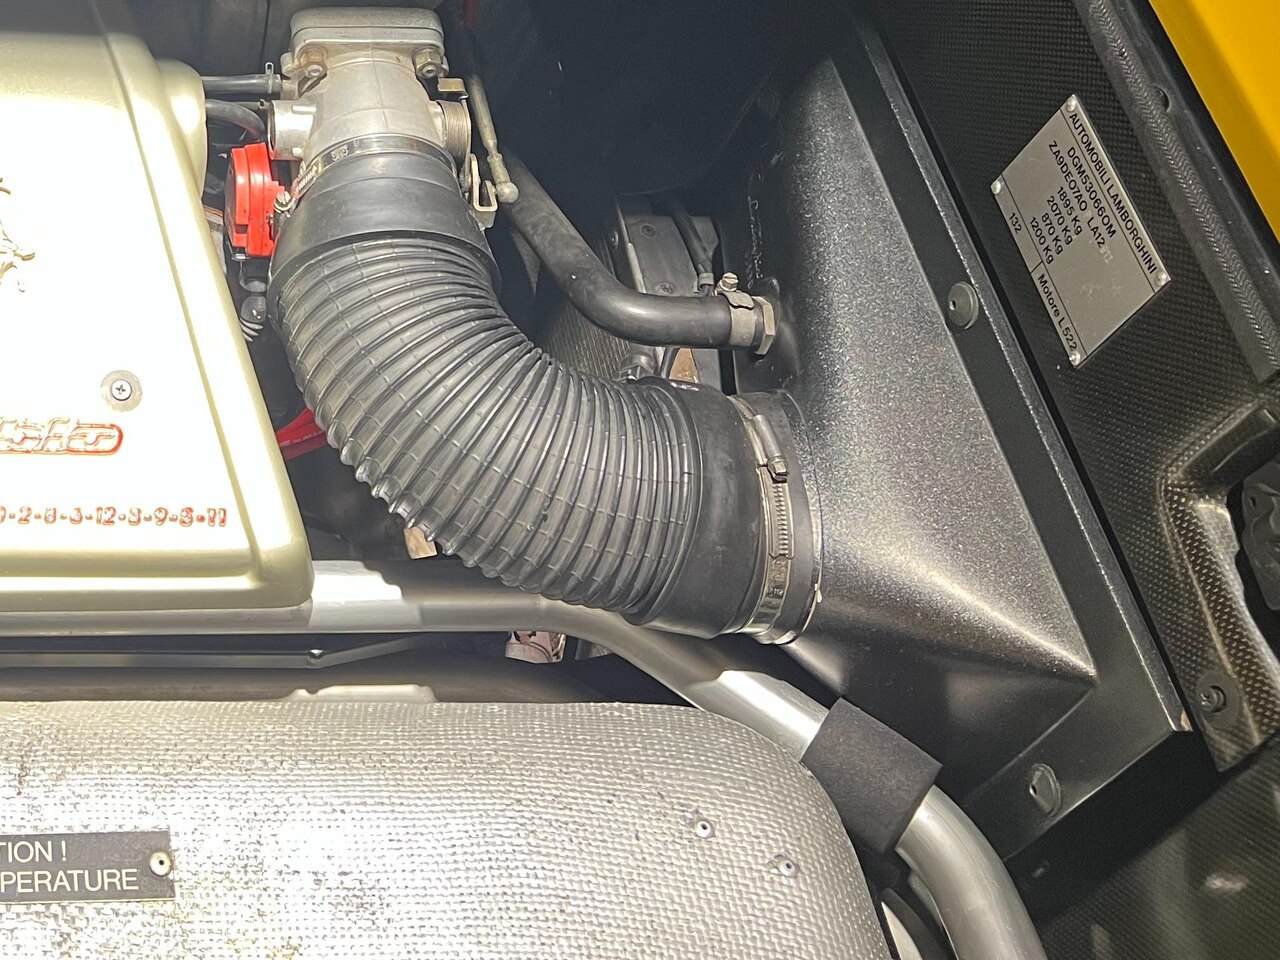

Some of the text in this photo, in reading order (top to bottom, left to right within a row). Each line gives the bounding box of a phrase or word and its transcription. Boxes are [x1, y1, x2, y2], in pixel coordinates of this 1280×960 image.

[1057, 186, 1083, 235] 1895 Kg
[1069, 112, 1157, 275] AUTOMOBILI LAMBORGHINI
[1009, 212, 1022, 234] 132
[1029, 217, 1055, 265] 1200 Kg
[1041, 213, 1064, 255] 870 Kg
[1046, 196, 1074, 245] 2070 Kg
[1037, 273, 1060, 317] Motore
